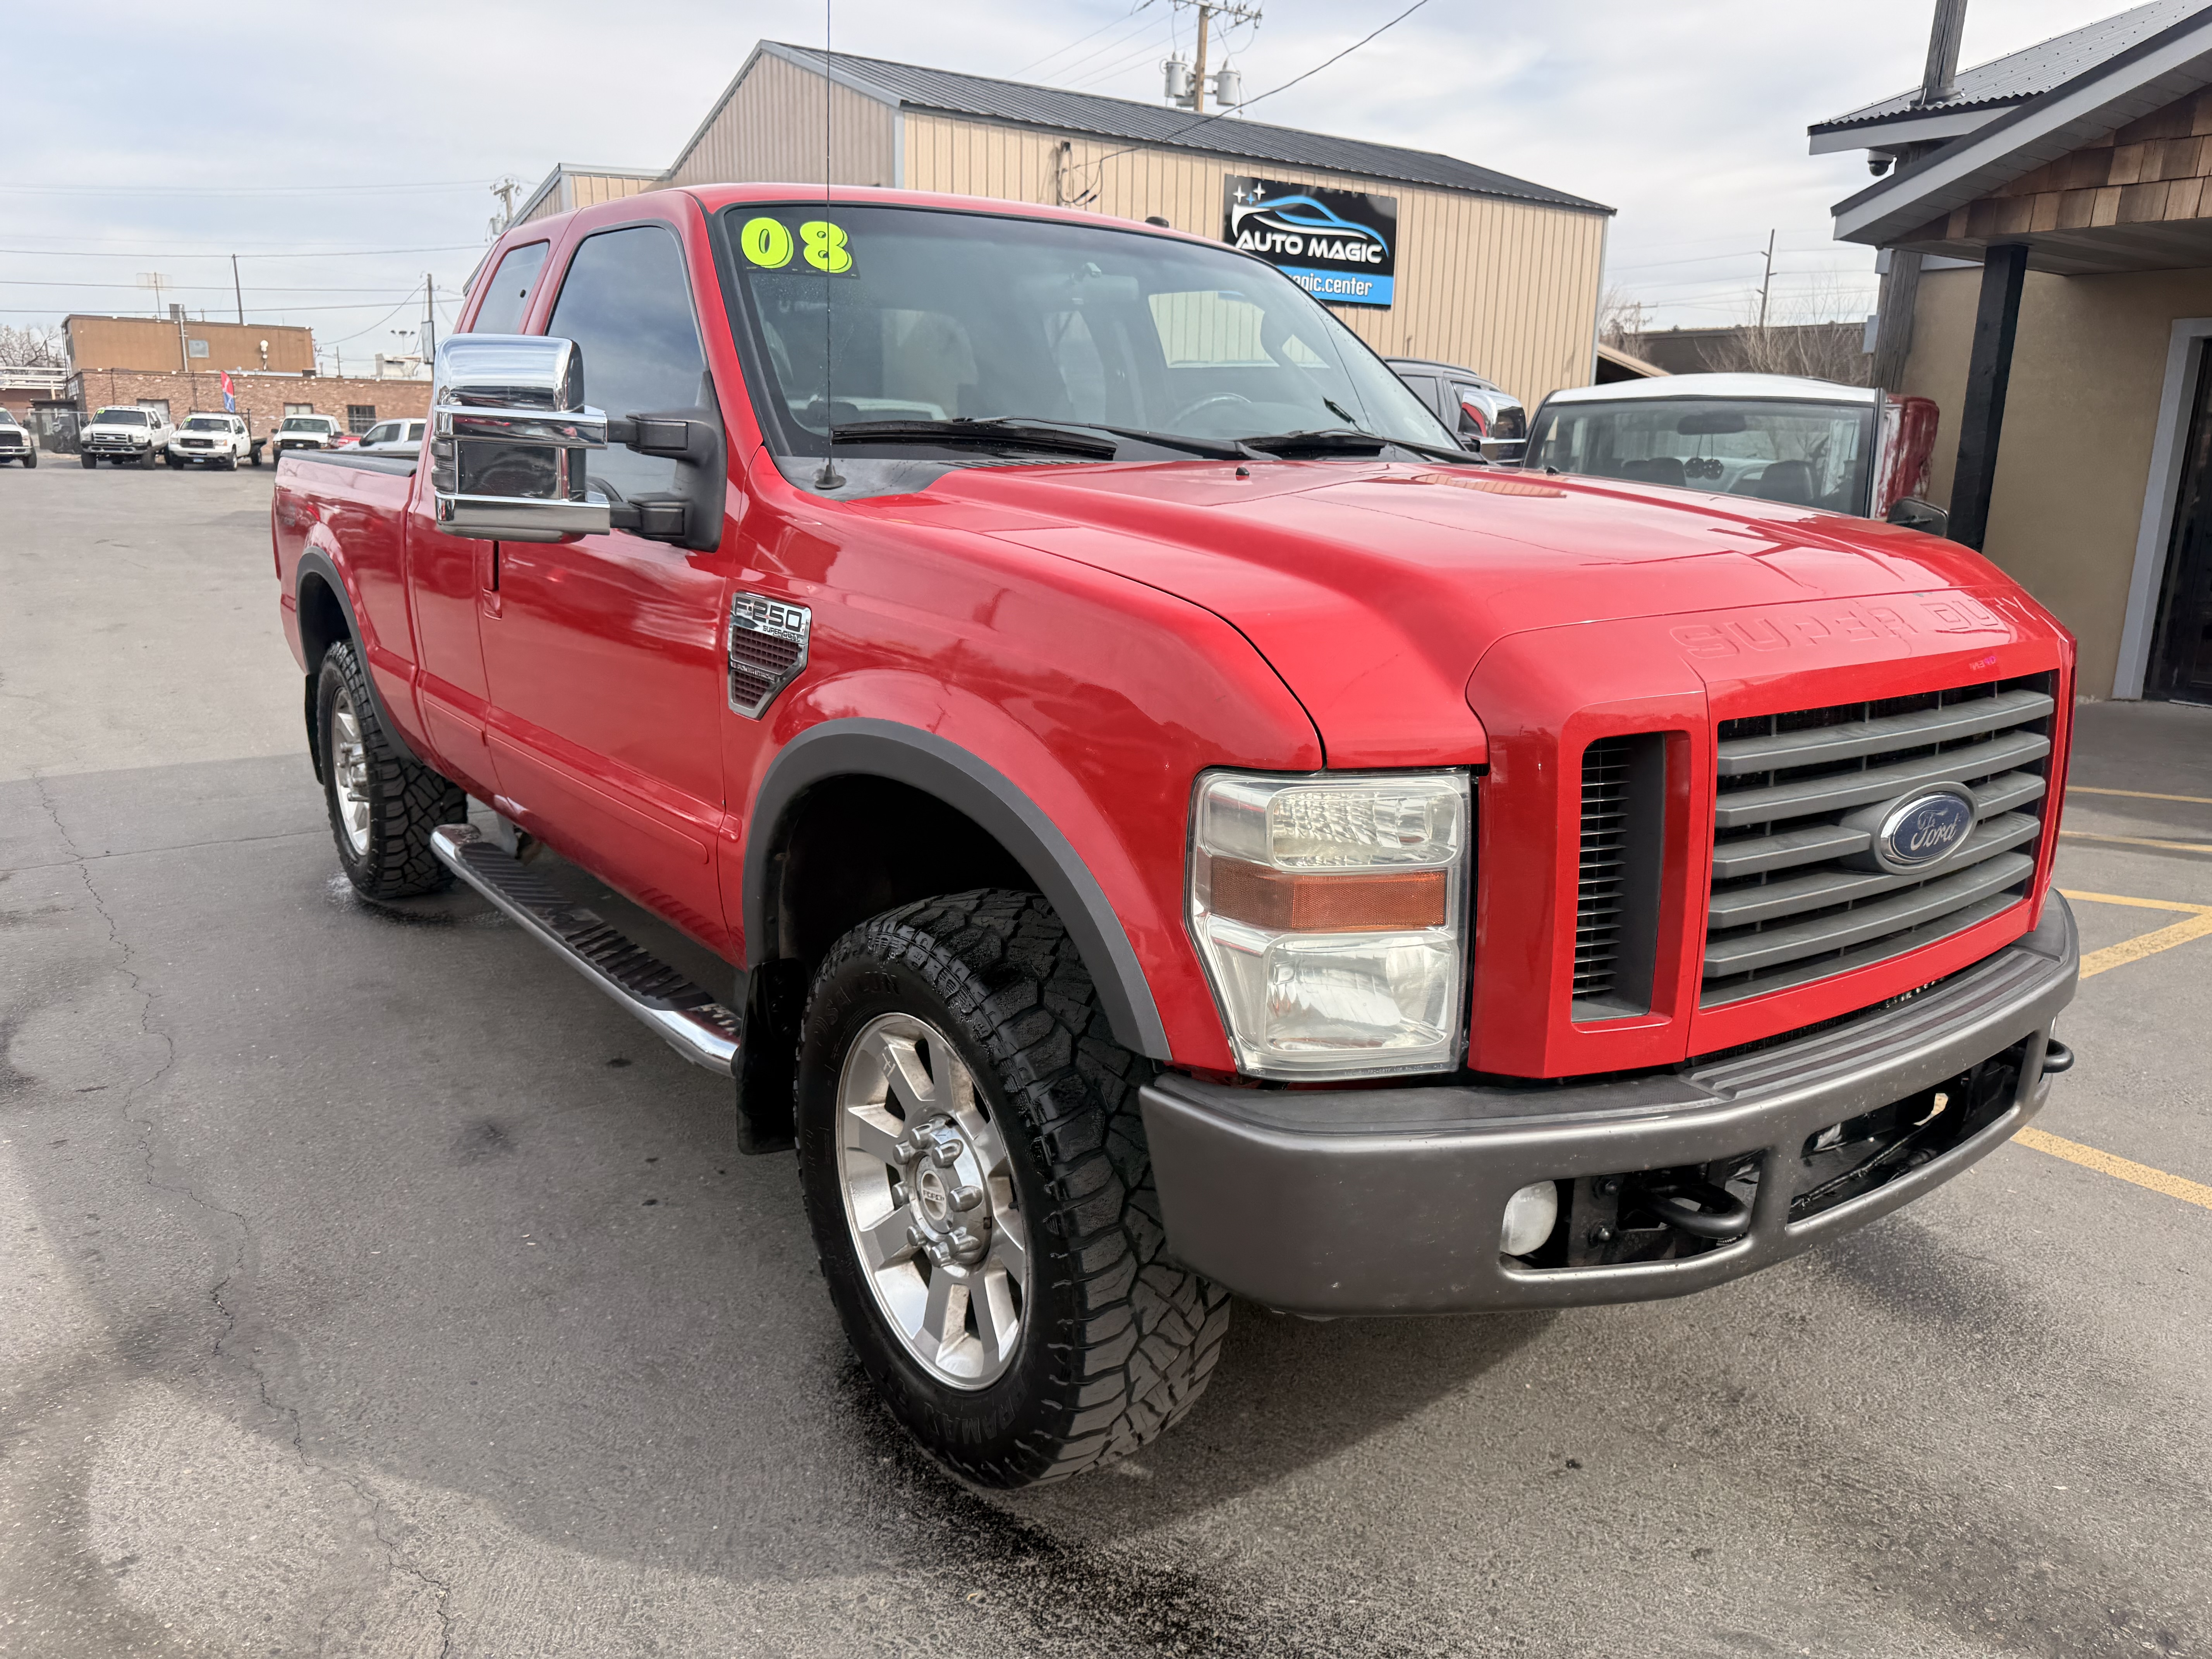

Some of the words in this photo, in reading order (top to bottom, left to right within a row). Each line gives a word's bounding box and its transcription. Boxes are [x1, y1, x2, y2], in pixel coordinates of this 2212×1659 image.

[741, 217, 852, 273] 08
[1235, 229, 1303, 255] AUTO
[1307, 237, 1383, 264] MAGIC
[1288, 272, 1373, 296] agic.center
[735, 597, 802, 632] F-250
[1669, 607, 1918, 659] SUPER
[1919, 596, 2037, 630] DUTY
[1910, 808, 1960, 851] Ford
